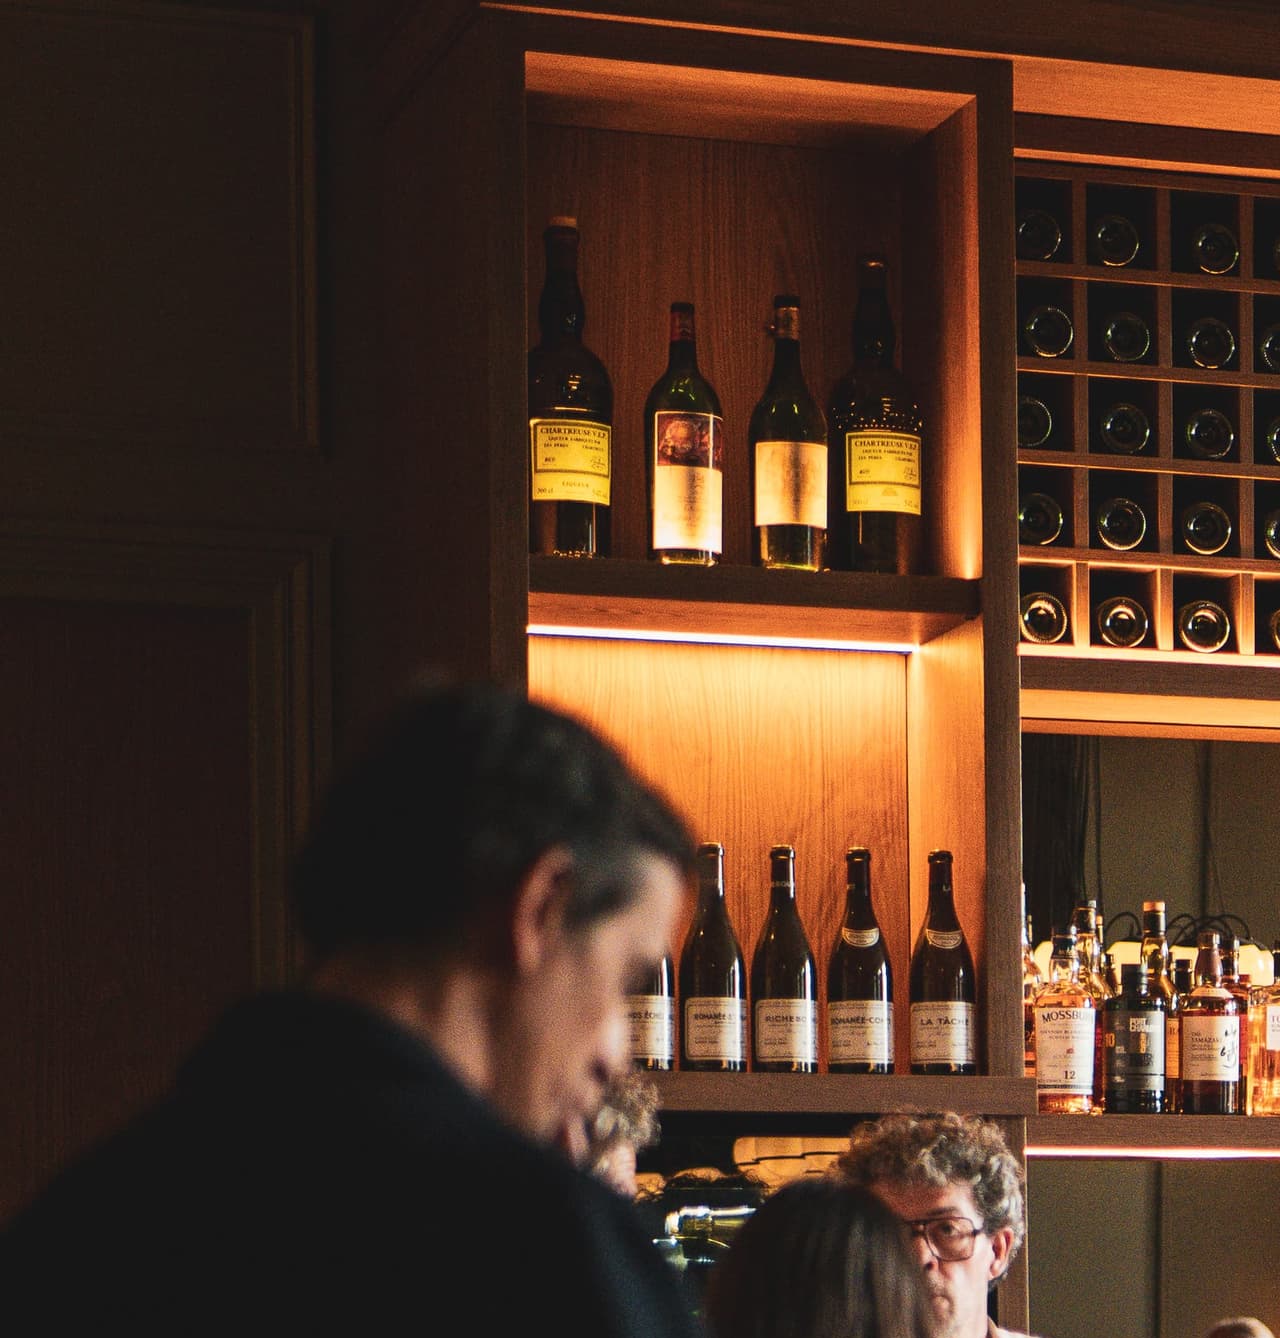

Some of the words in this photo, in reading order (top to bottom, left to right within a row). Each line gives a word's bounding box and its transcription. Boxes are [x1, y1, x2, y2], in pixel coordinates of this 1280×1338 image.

[541, 427, 591, 436] CHARTREUSE
[854, 440, 905, 448] CHARTREUSE
[920, 1018, 933, 1026] LA
[1064, 1070, 1076, 1080] 12
